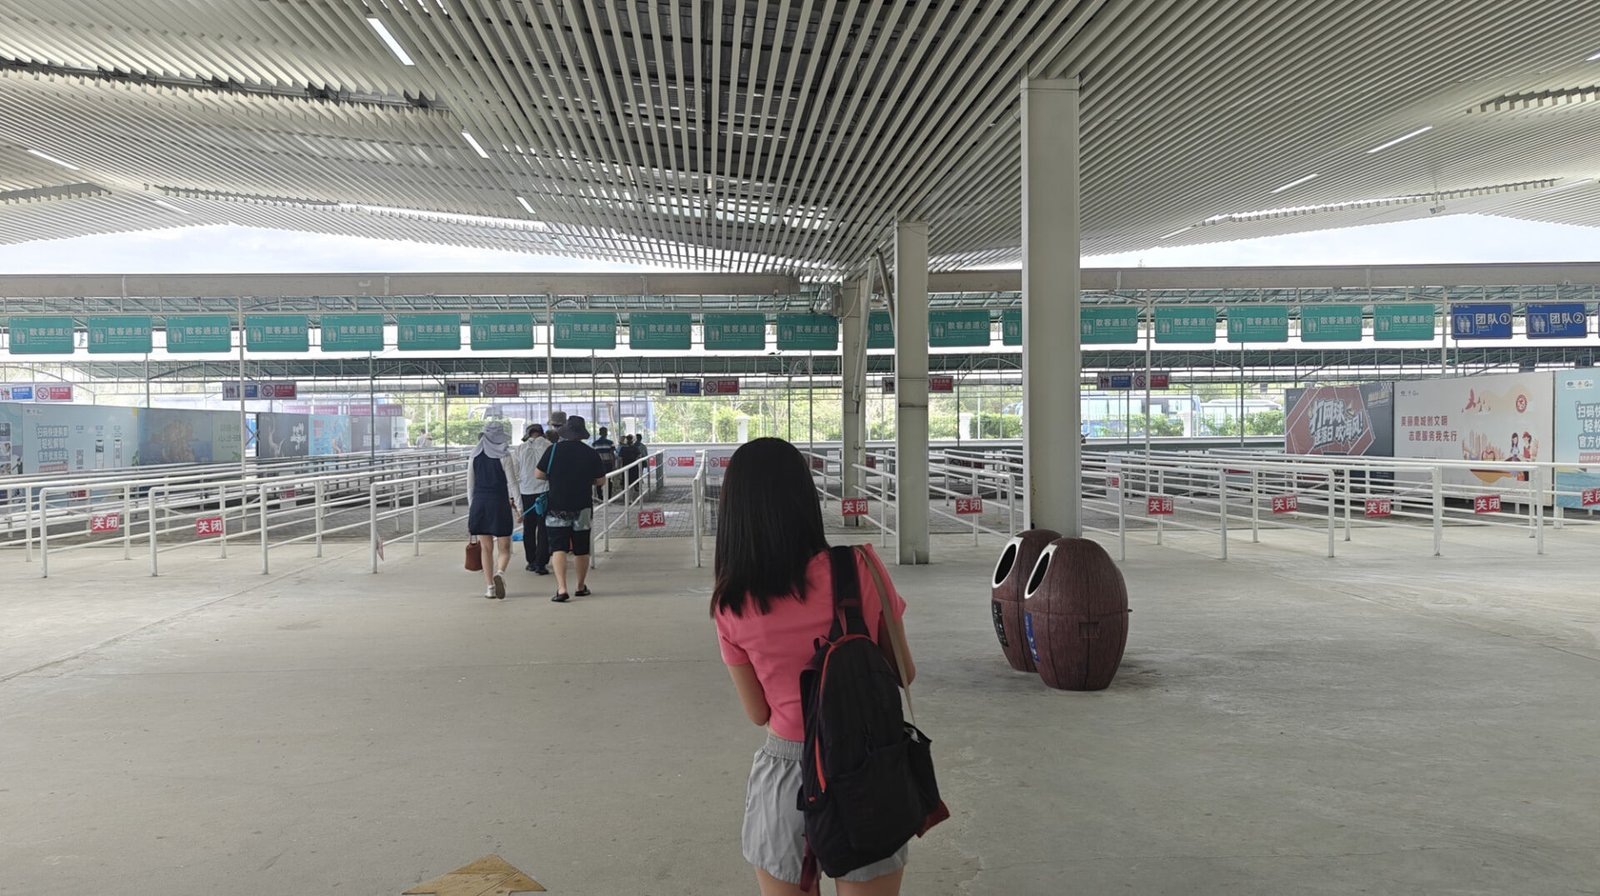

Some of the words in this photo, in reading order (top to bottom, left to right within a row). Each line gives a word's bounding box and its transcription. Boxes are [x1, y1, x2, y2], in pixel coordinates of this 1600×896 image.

[1408, 431, 1457, 442] 志愿服务我先行
[843, 499, 867, 513] 关闭
[957, 499, 981, 512] 关闭
[1149, 499, 1173, 513] 关闭
[1274, 497, 1297, 510] 关闭
[1366, 502, 1391, 514] 关闭
[1476, 496, 1500, 511] 关闭
[93, 516, 118, 529] 关闭
[640, 511, 665, 525] 关闭
[198, 519, 223, 533] 关闭
